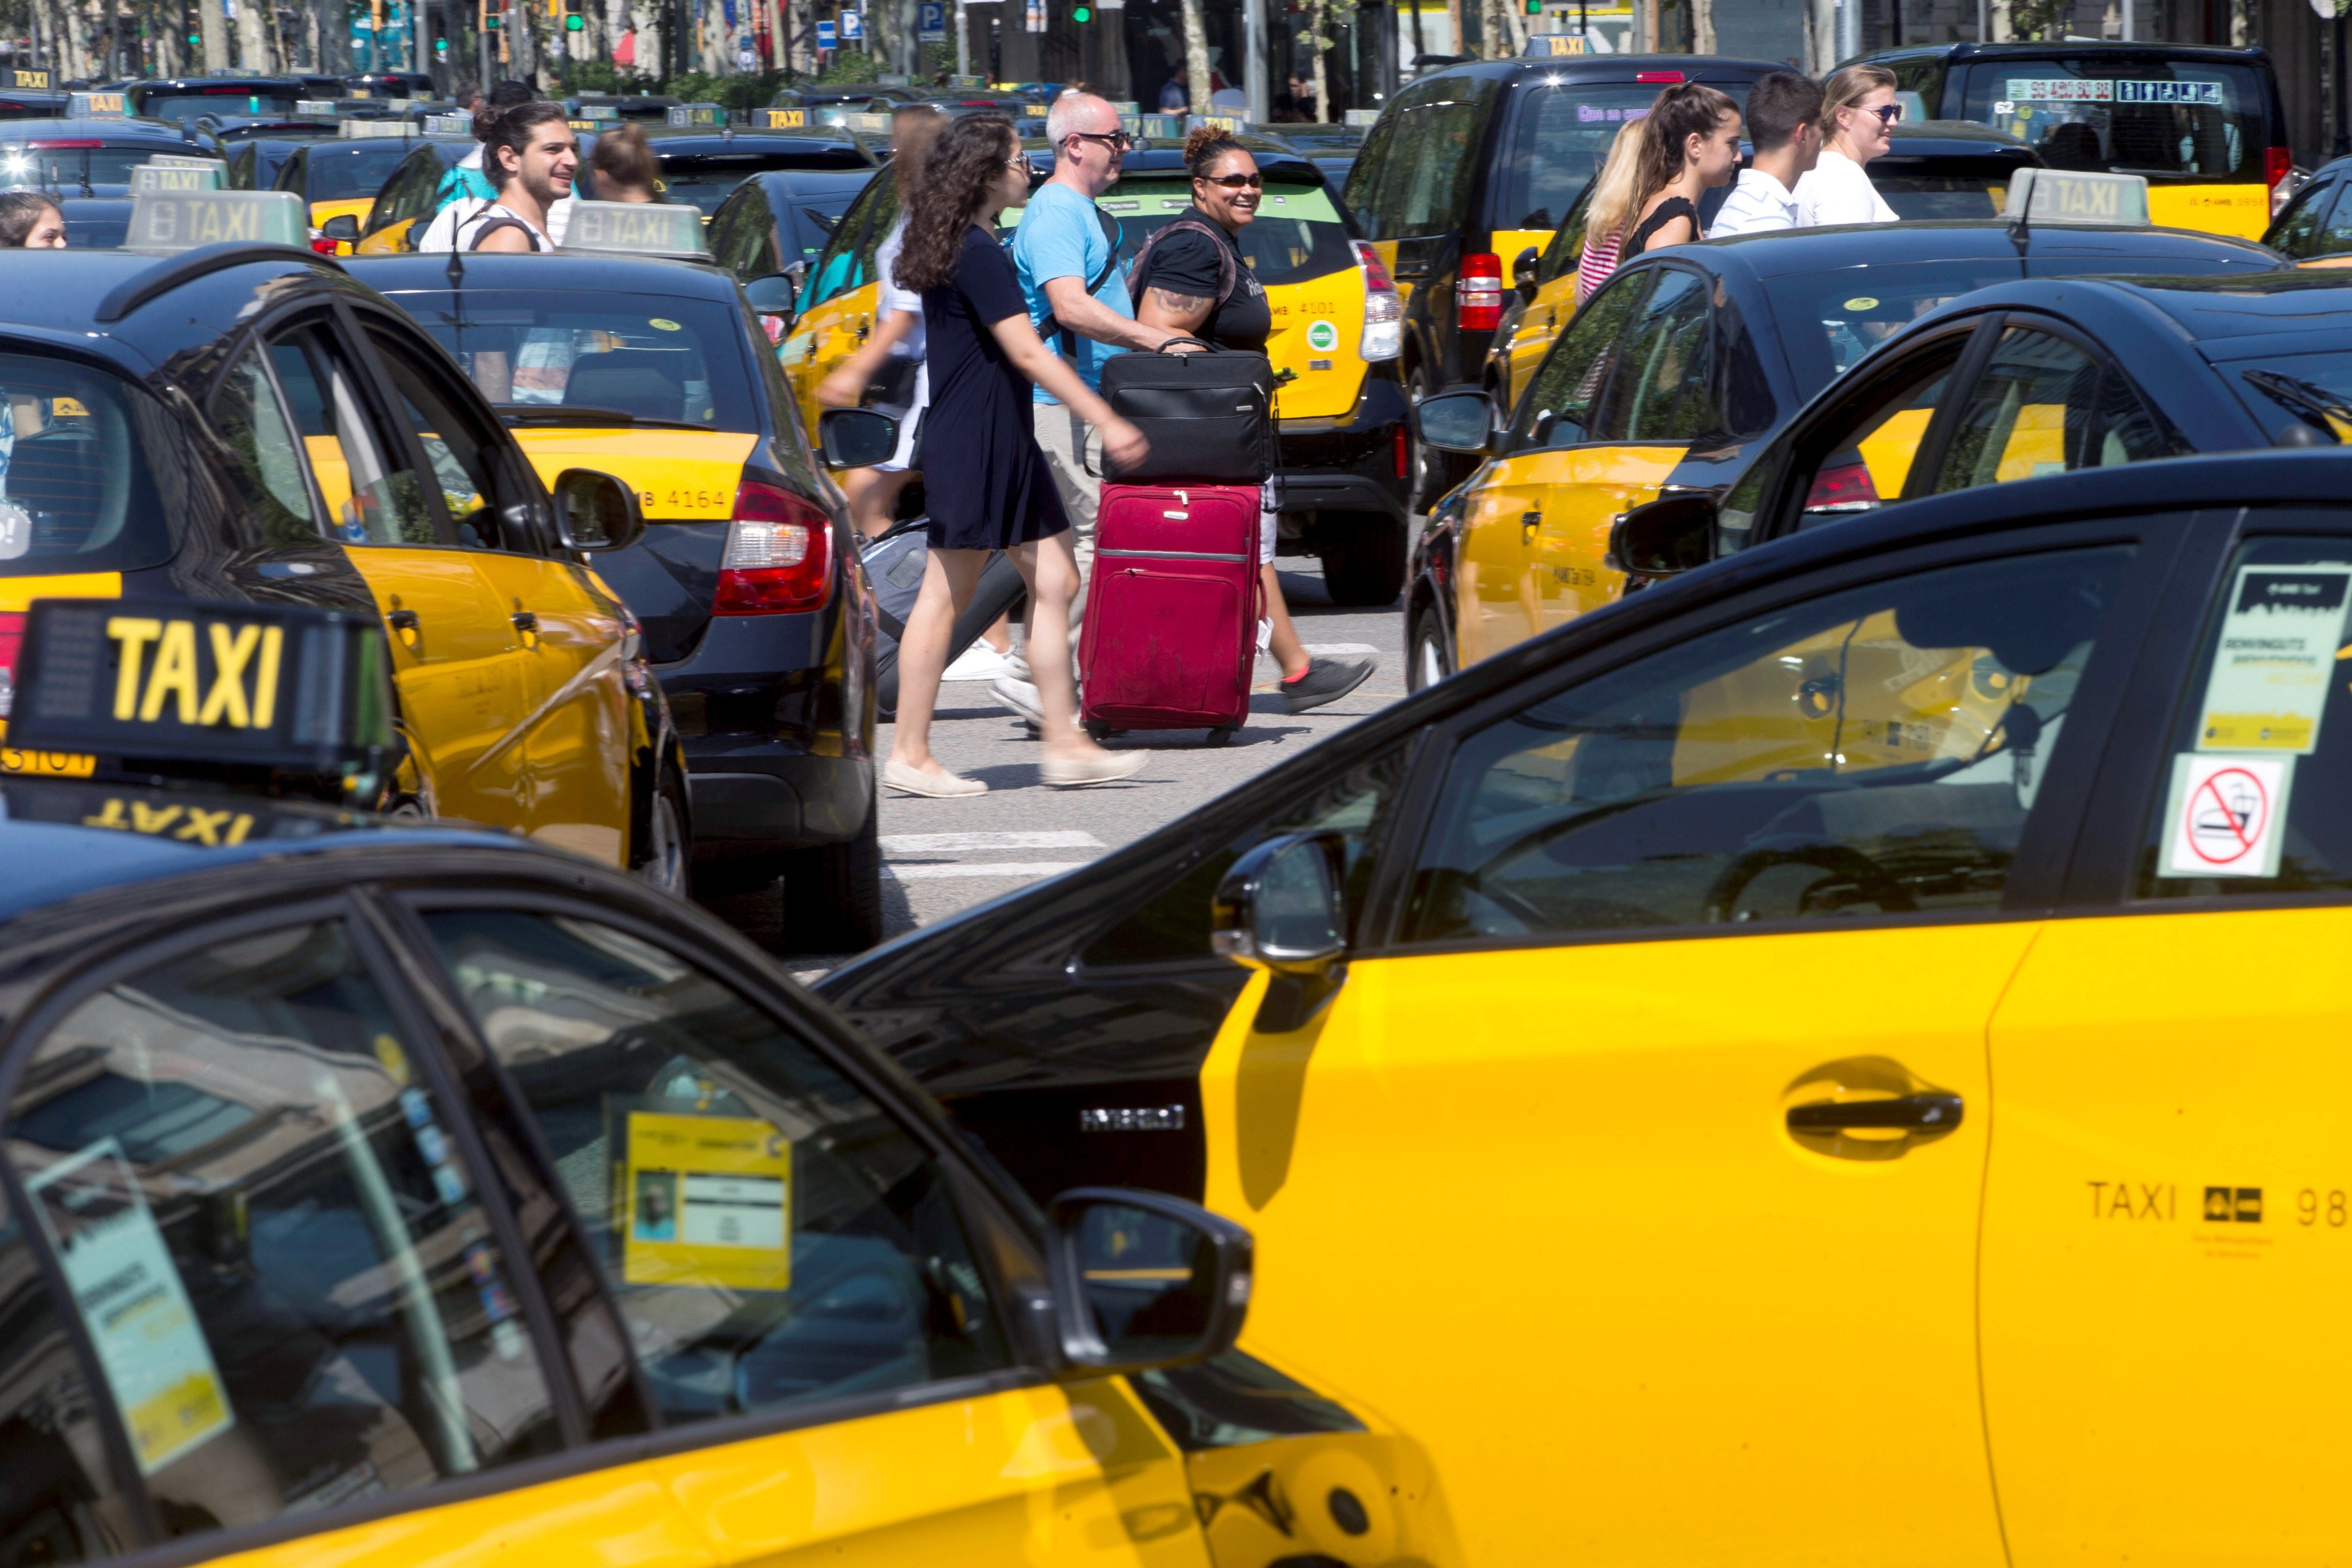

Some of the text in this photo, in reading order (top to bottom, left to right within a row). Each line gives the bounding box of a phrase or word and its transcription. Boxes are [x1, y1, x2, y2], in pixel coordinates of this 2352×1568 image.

[844, 13, 860, 35] P
[922, 6, 939, 28] P
[1548, 37, 1584, 56] TAXI
[13, 70, 48, 88] TAXI
[87, 94, 122, 111] TAXI
[1994, 101, 2014, 114] 62
[767, 110, 804, 128] TAXI
[1577, 106, 1605, 121] Que
[158, 171, 199, 190] TAXI
[2055, 180, 2119, 215] TAXI
[184, 200, 259, 241] TAXI
[610, 210, 670, 245] TAXI
[1300, 302, 1335, 314] 4101
[667, 490, 725, 508] 4164
[106, 617, 284, 729] TAXI
[2086, 1180, 2348, 1228] TAXI 98
